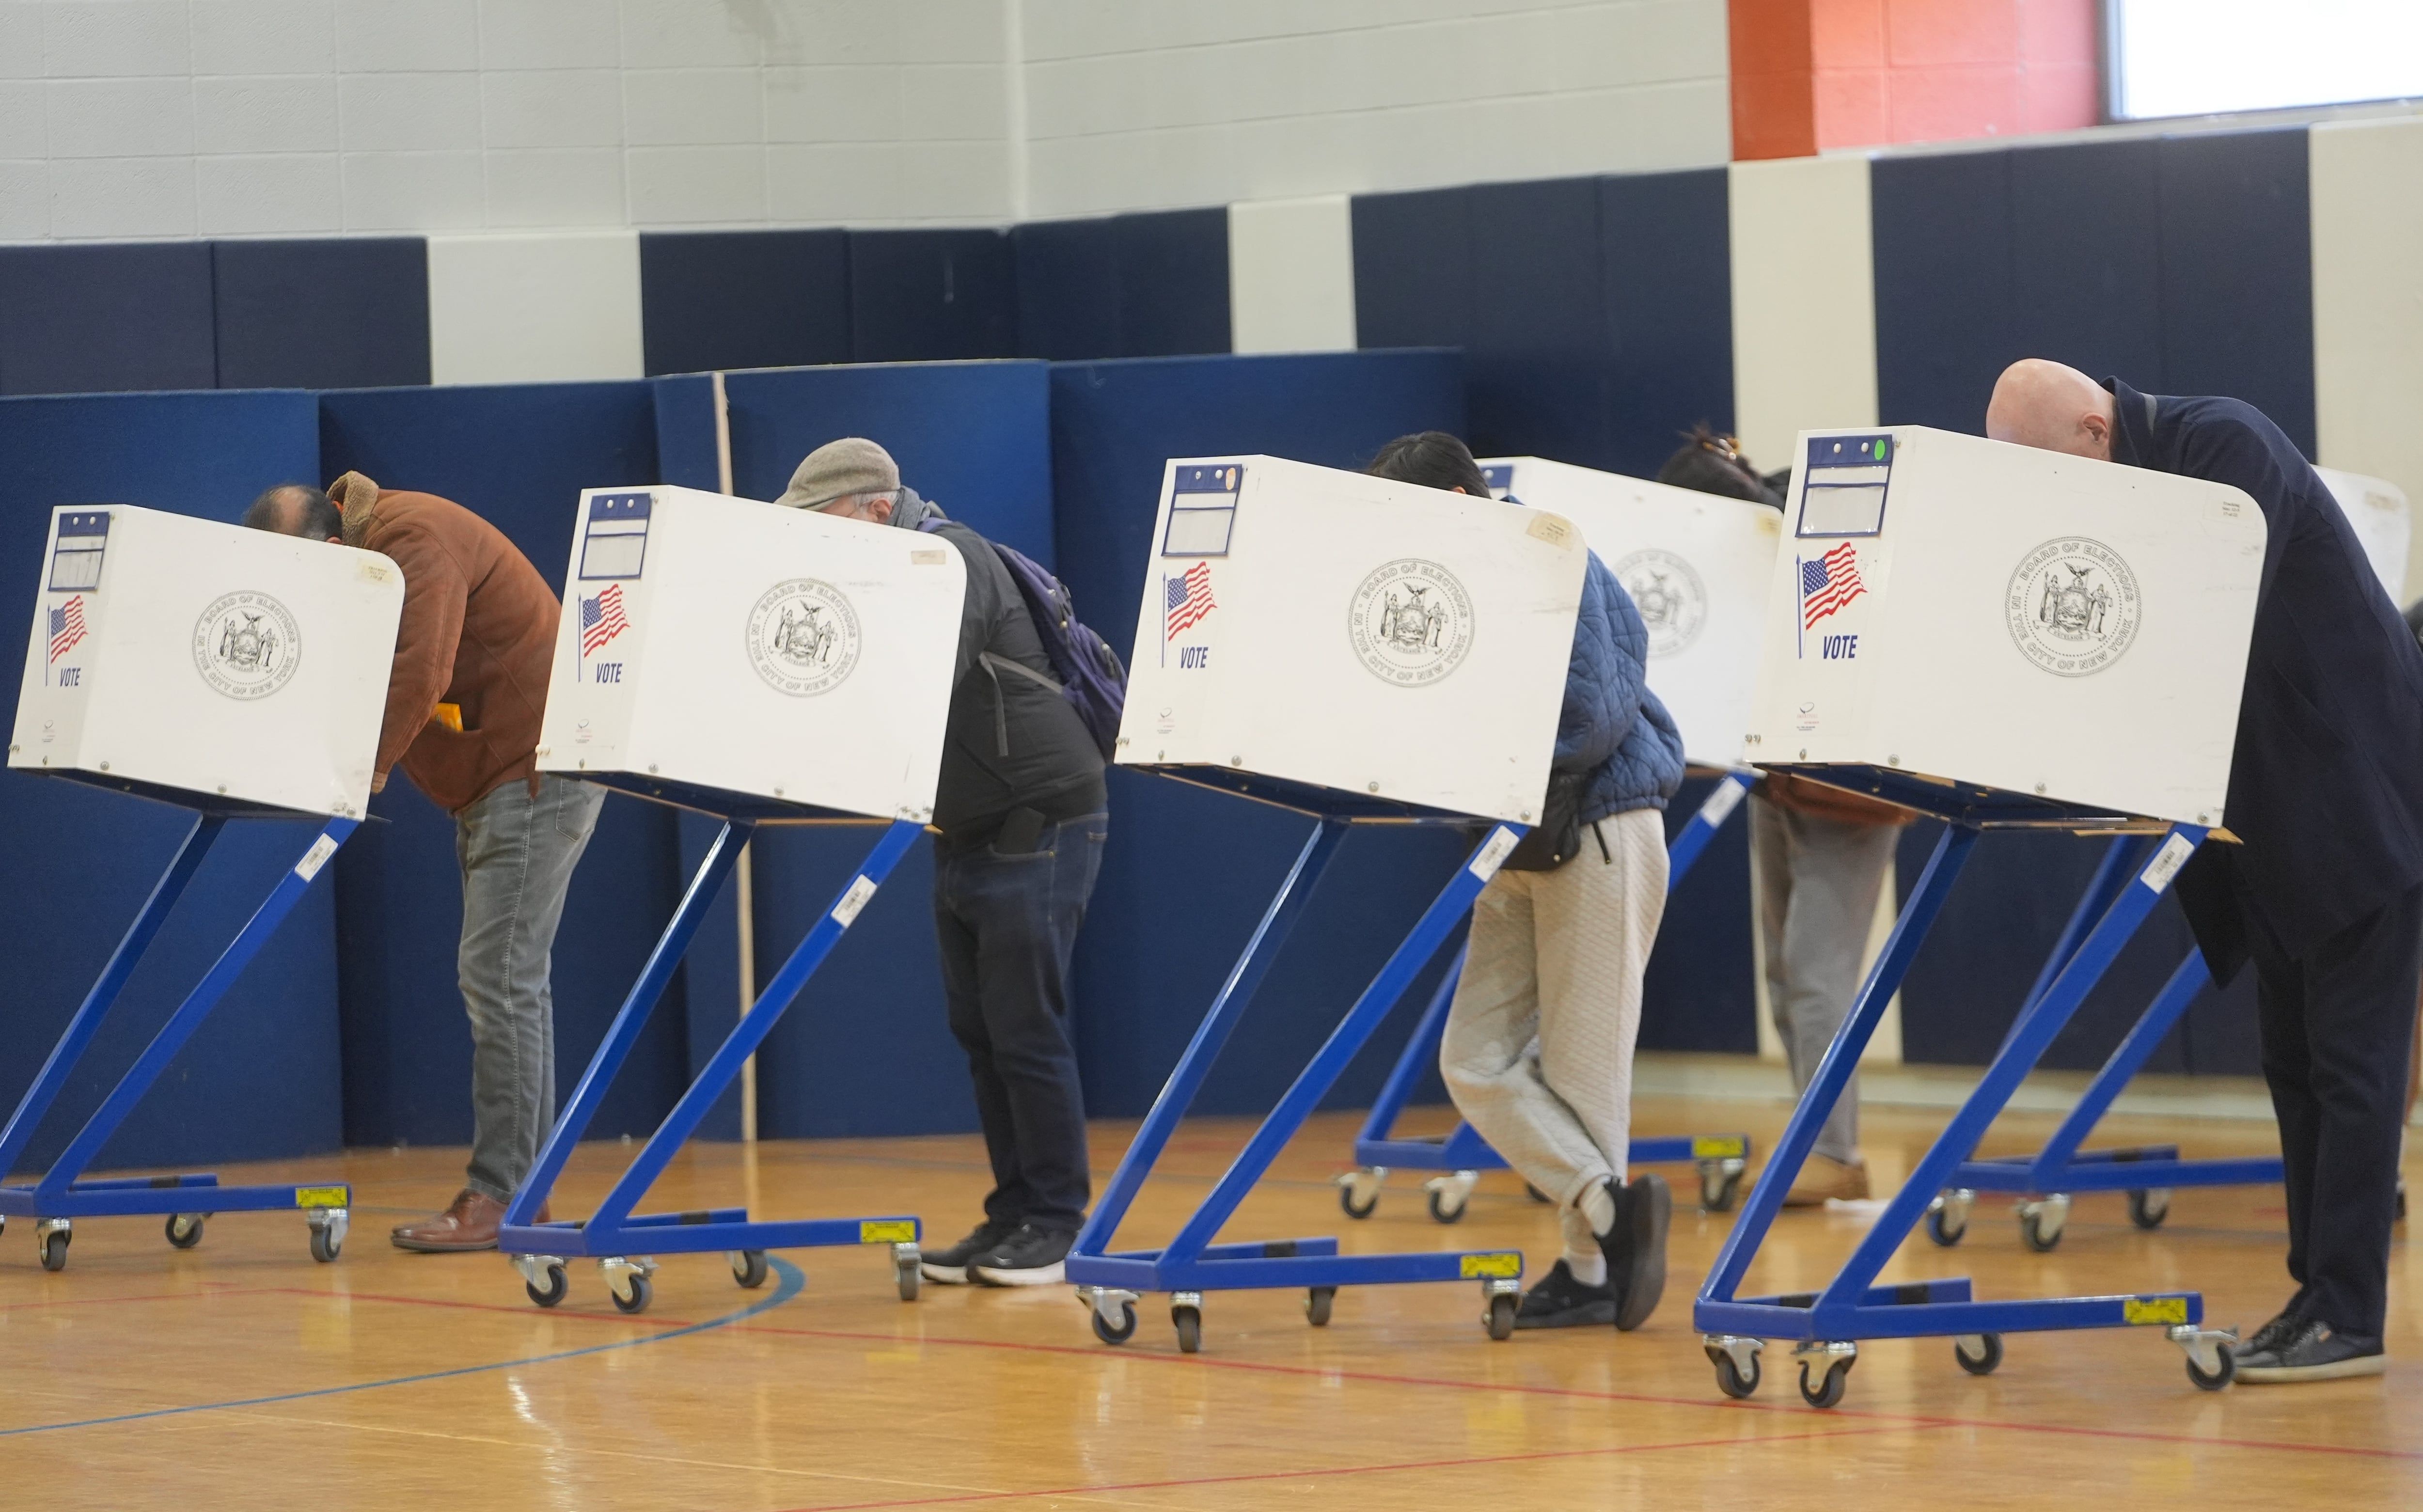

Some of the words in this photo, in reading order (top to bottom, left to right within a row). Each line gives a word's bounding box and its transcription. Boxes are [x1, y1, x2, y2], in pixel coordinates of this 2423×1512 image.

[2019, 546, 2058, 581] BOARD
[2062, 543, 2079, 552] OF
[2084, 545, 2134, 602] ELECTIONS
[1362, 568, 1397, 598] BOARD
[1401, 564, 1417, 573] OF
[1421, 567, 1468, 619] ELECTIONS
[761, 586, 795, 612] BOARD
[799, 583, 814, 592] OF
[817, 586, 856, 638] ELECTIONS
[2012, 596, 2021, 609] IN
[205, 598, 236, 624] BOARD
[256, 597, 296, 643] ELECTIONS
[751, 624, 760, 636] IN
[1354, 613, 1363, 626] IN
[2013, 614, 2030, 640] THE
[197, 635, 205, 646] IN
[1355, 630, 1370, 654] THE
[2108, 618, 2133, 652] YORK
[752, 638, 764, 662] THE
[1180, 646, 1209, 669] VOTE
[1445, 634, 1467, 665] YORK
[1823, 635, 1858, 659] VOTE
[2027, 642, 2056, 665] CITY
[198, 650, 210, 671] THE
[274, 656, 294, 682] YORK
[831, 651, 853, 679] YORK
[1369, 655, 1395, 676] CITY
[2058, 660, 2075, 669] OF
[2079, 650, 2108, 669] NEW
[60, 667, 81, 687] VOTE
[209, 672, 232, 690] CITY
[596, 663, 623, 683] VOTE
[761, 664, 785, 684] CITY
[1397, 672, 1413, 680] OF
[1416, 663, 1444, 680] NEW
[250, 681, 273, 694] NEW
[786, 682, 801, 690] OF
[804, 678, 829, 691] NEW
